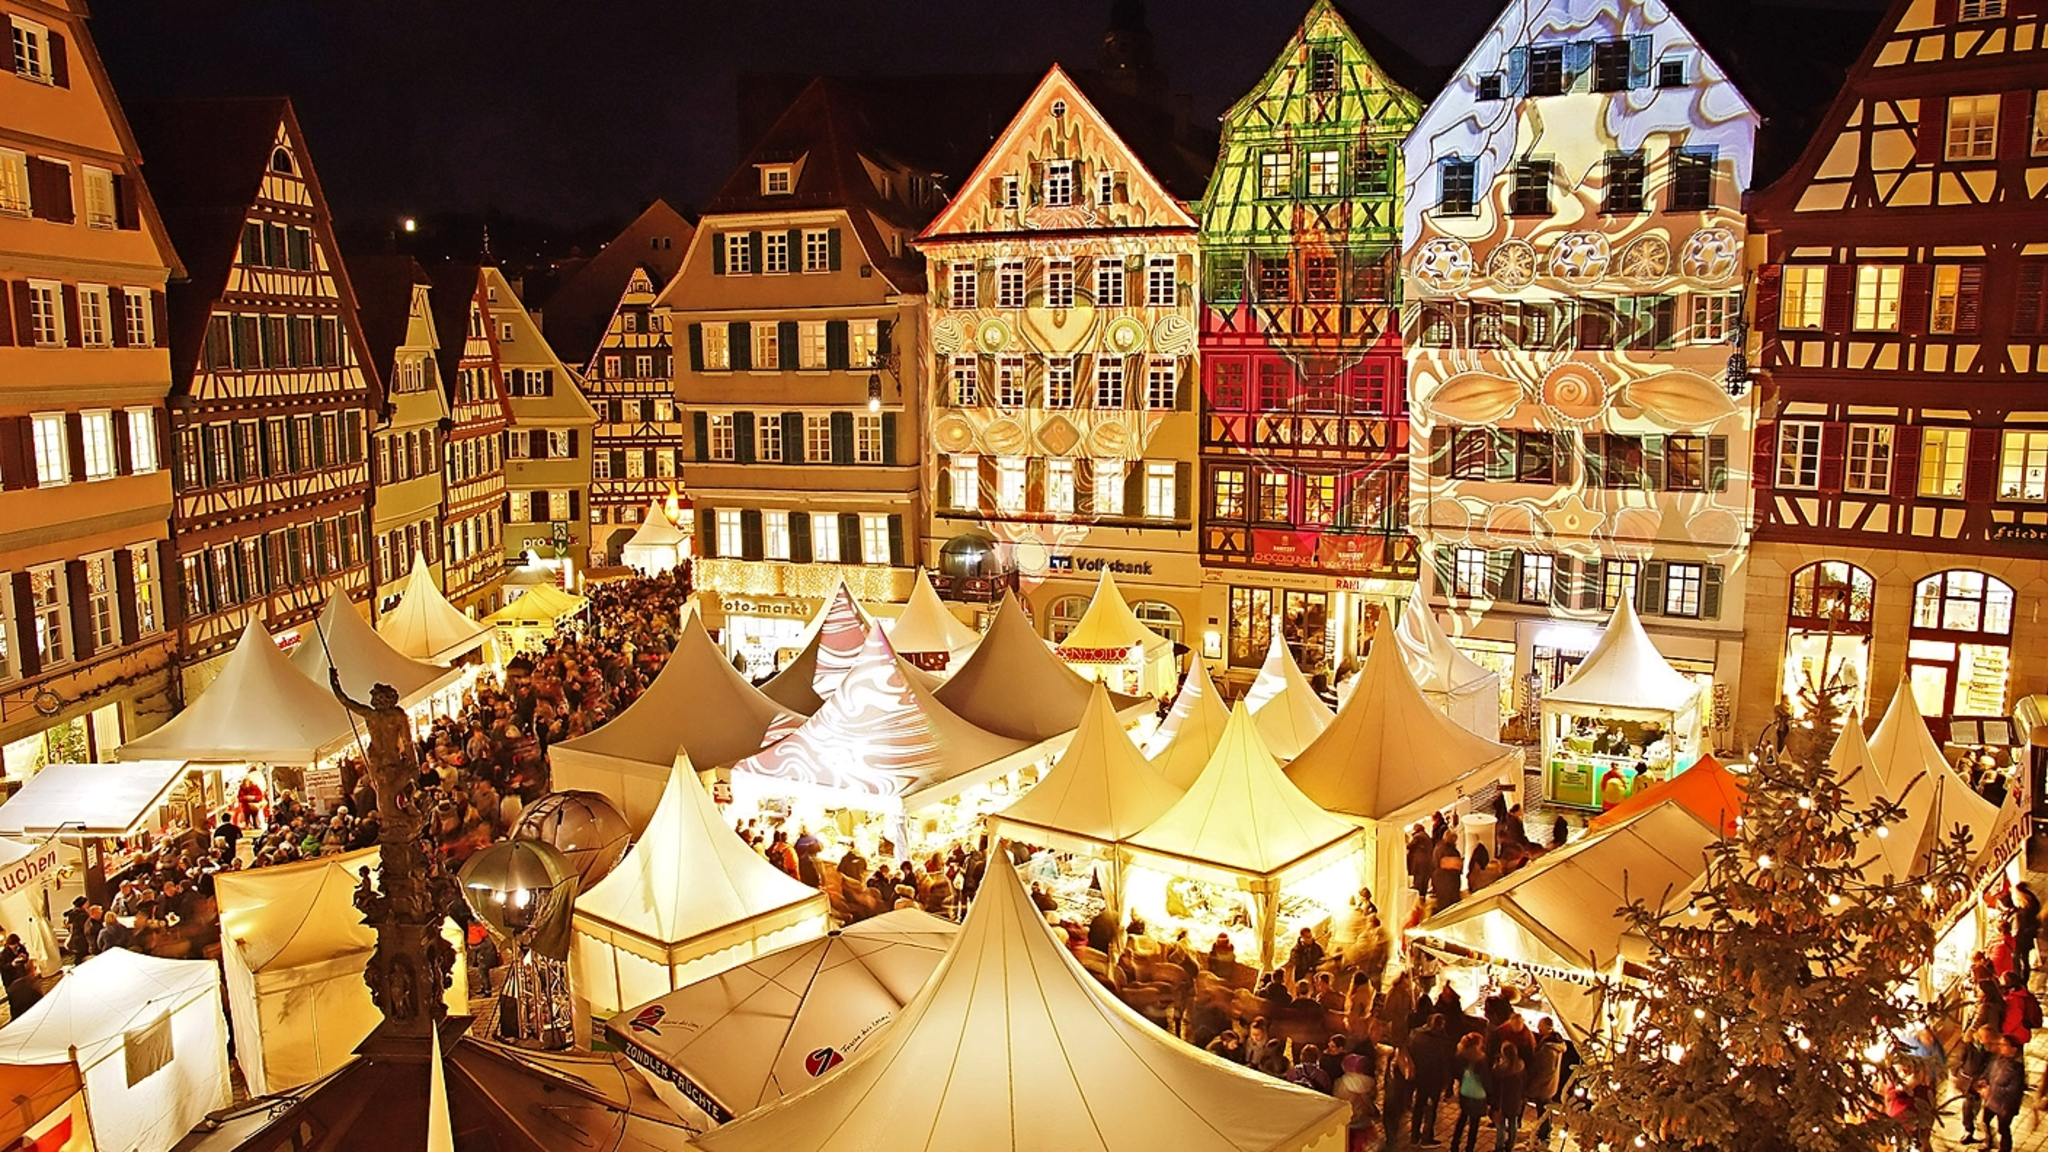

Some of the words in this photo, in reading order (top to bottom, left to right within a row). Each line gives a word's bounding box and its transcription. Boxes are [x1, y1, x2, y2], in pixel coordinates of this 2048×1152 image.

[1076, 558, 1153, 575] Volksbank
[0, 850, 57, 895] uchen
[625, 1042, 669, 1079] ZONDLER
[671, 1071, 720, 1119] FRÜCHTE
